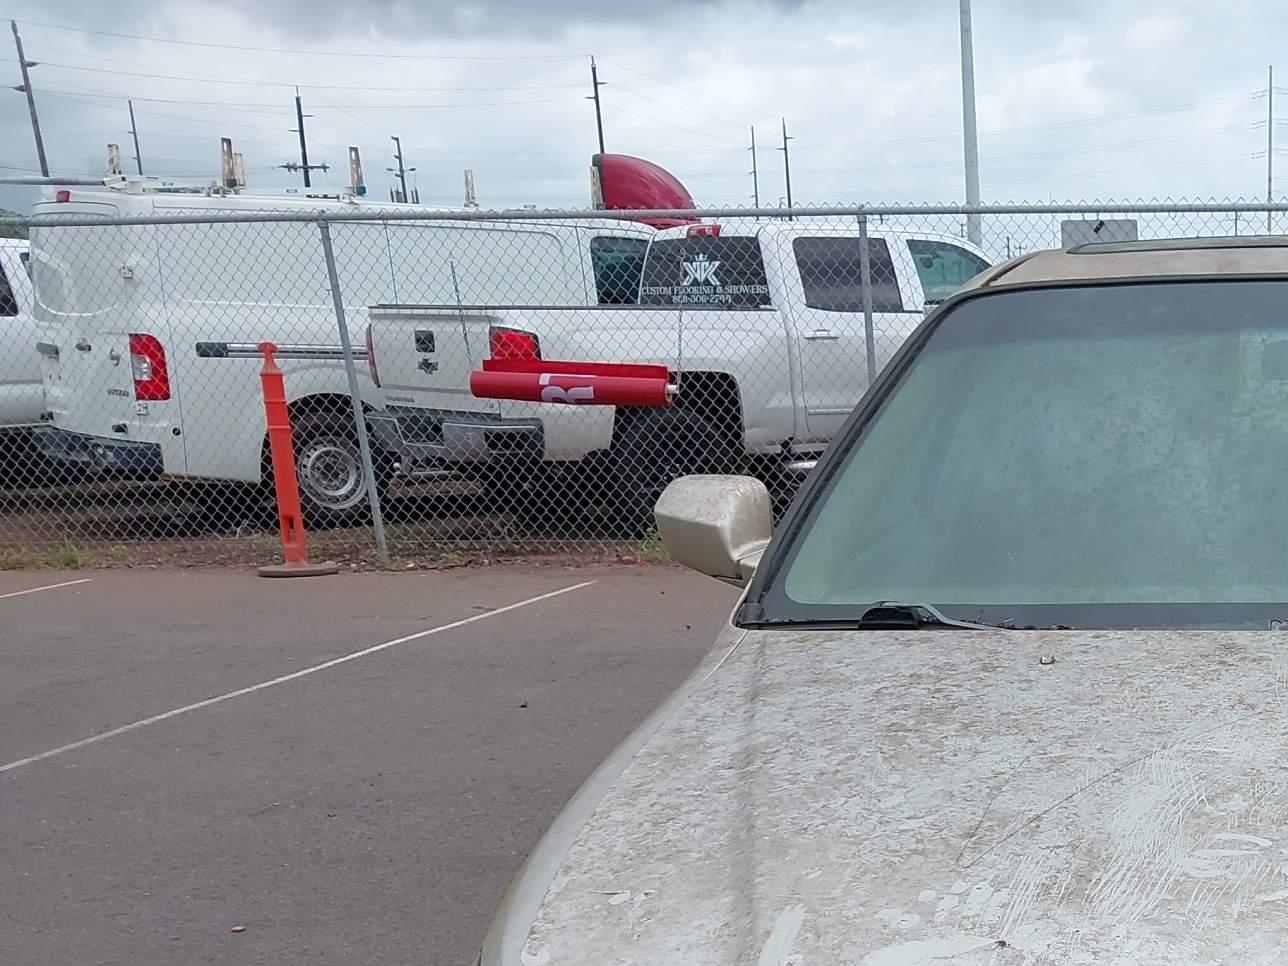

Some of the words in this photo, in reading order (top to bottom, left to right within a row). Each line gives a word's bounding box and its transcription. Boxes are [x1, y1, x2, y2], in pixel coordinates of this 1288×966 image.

[641, 286, 672, 295] CUSTOM
[674, 286, 714, 295] FLOORING
[725, 285, 769, 294] SHOWERS
